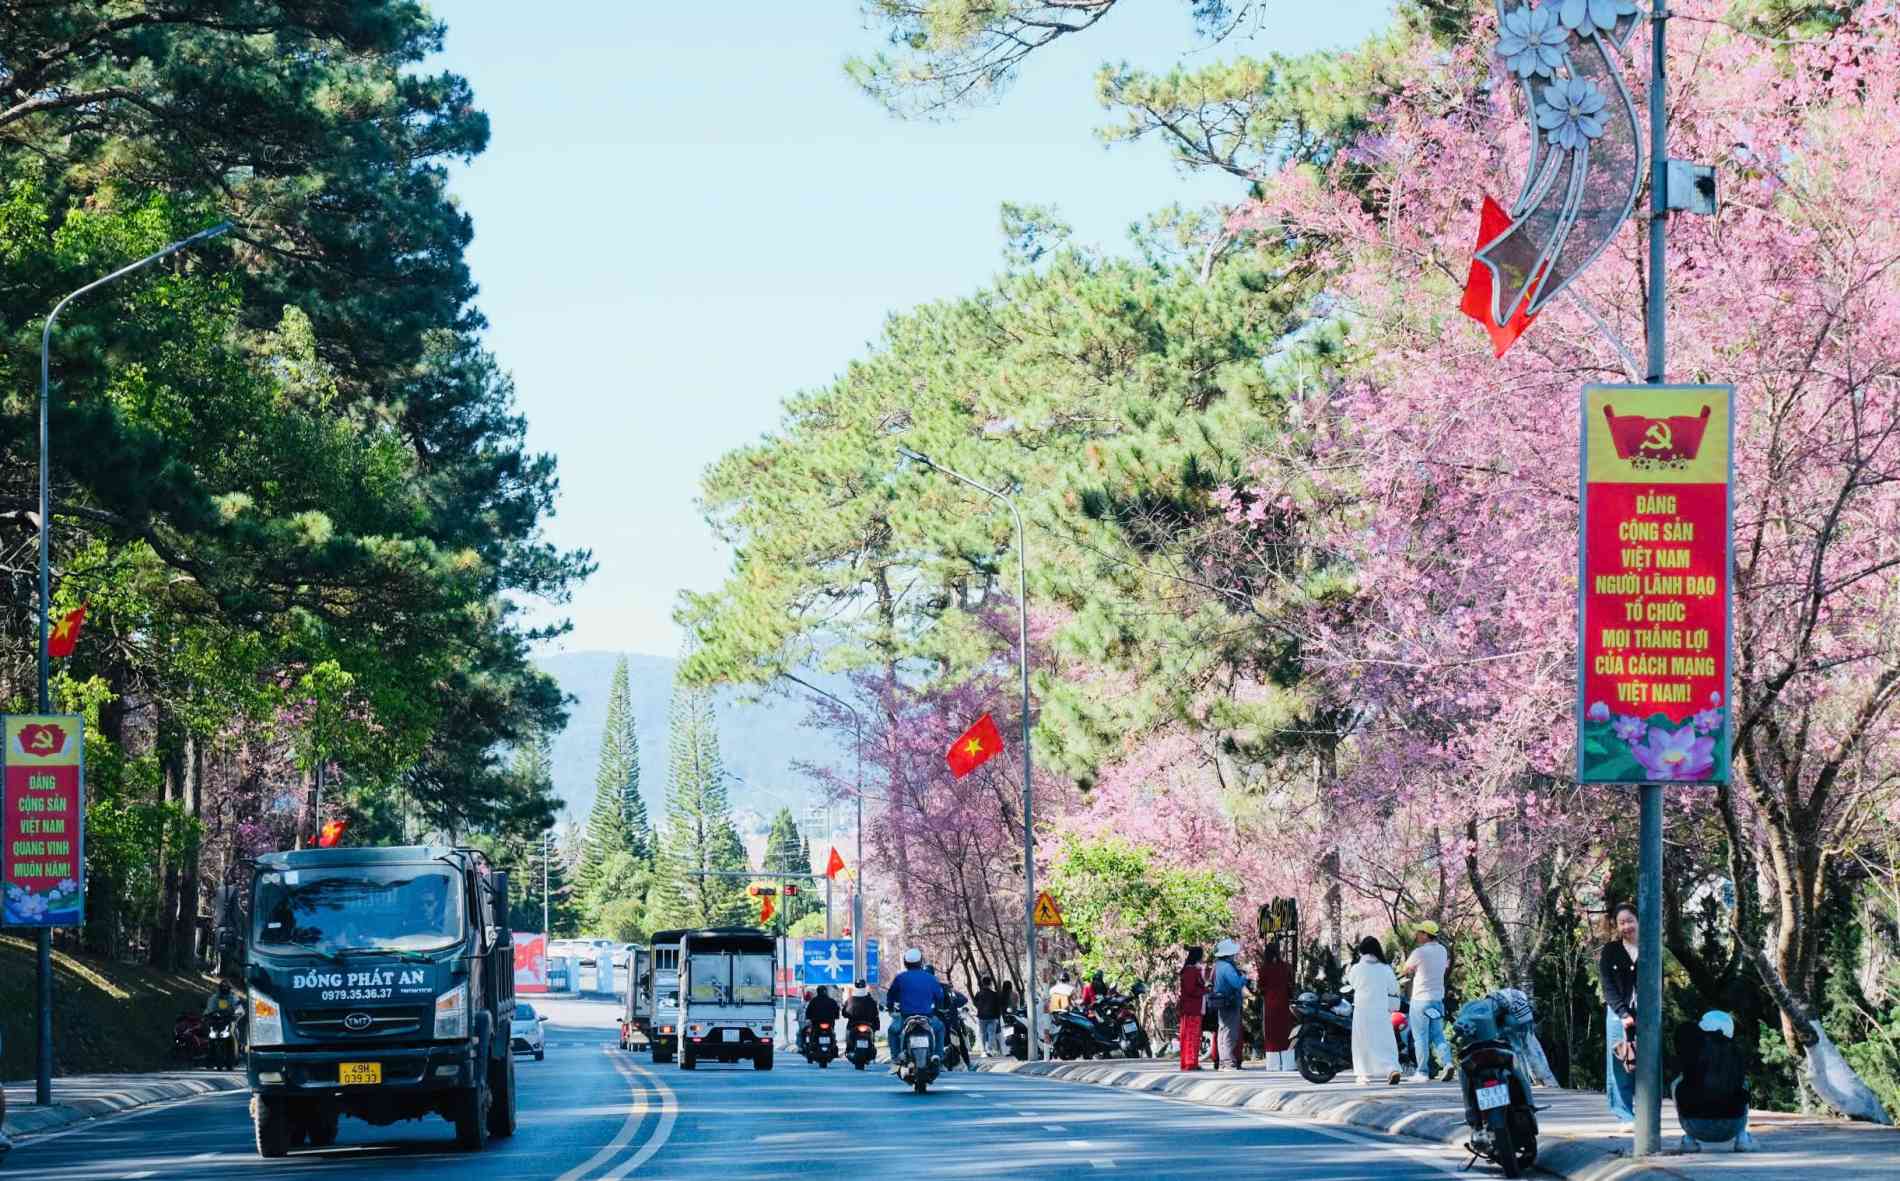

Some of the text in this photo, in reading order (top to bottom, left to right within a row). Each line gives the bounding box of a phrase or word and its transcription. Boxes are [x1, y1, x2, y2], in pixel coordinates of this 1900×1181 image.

[1636, 489, 1677, 515] ĐẢNG
[1619, 516, 1694, 544] CỘNG SẢN
[1621, 545, 1691, 572] VIỆT NAM
[1595, 571, 1716, 600] NGƯỜI LÃNH ĐẠO
[1647, 599, 1686, 622] CHỨC
[1602, 623, 1709, 653] MỌI THẮNG LỢI
[1595, 650, 1715, 680] CỦA CÁCH MẠNG
[1617, 679, 1691, 706] VIỆT NAM!
[20, 816, 65, 836] VIỆT NAM
[13, 841, 70, 856] QUANG VINH
[346, 968, 395, 987] PHÁT
[397, 969, 425, 985] AN
[321, 988, 393, 1001] 0979.35.36.37
